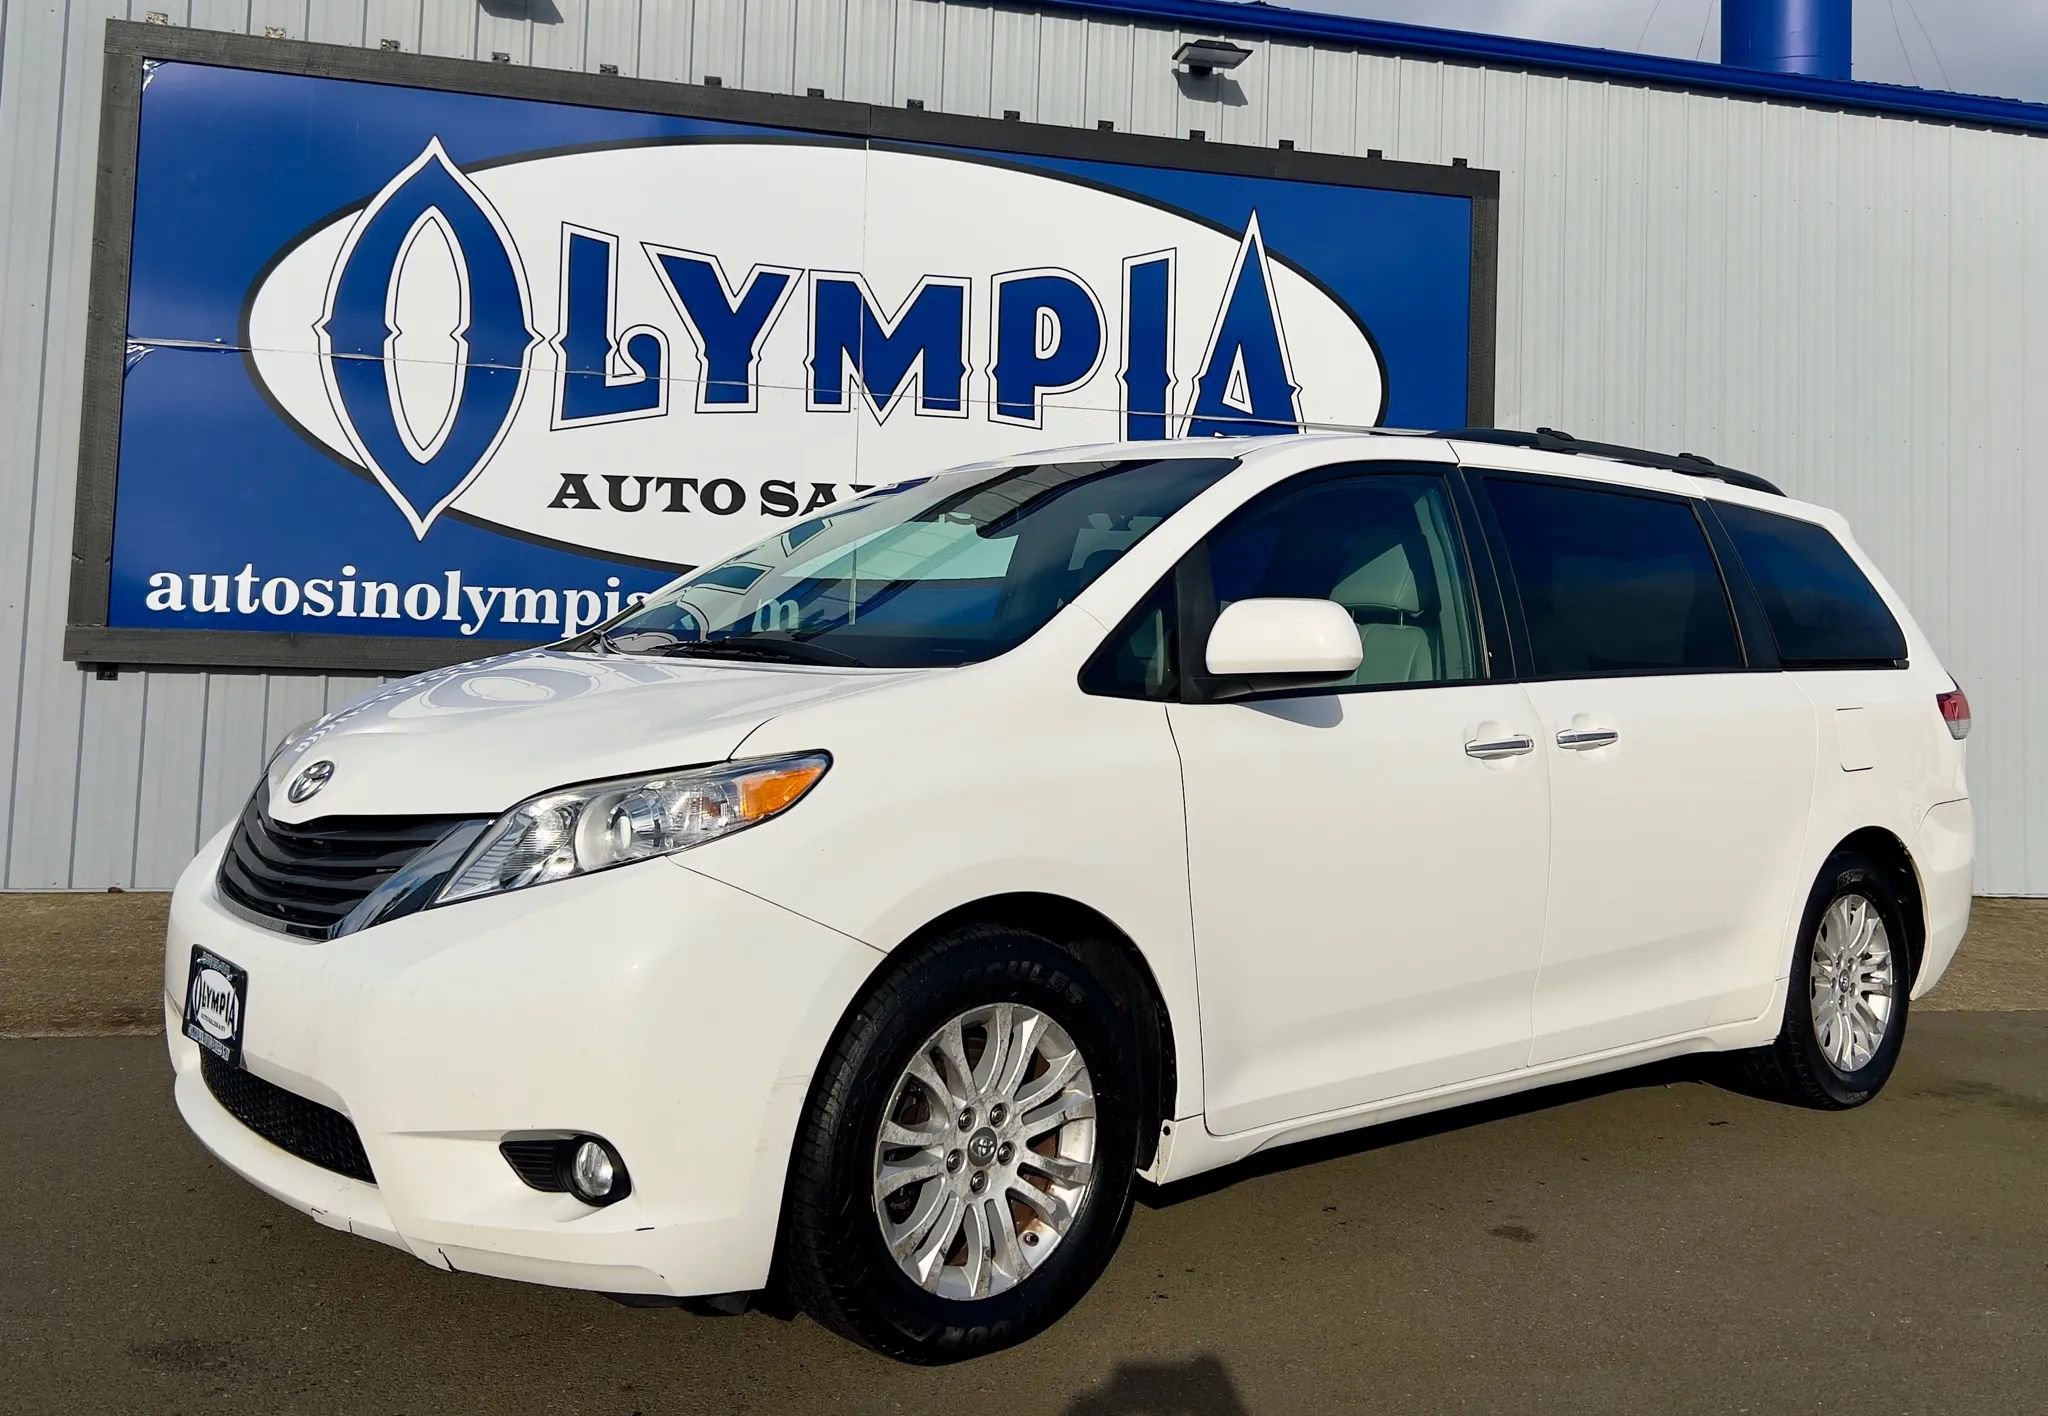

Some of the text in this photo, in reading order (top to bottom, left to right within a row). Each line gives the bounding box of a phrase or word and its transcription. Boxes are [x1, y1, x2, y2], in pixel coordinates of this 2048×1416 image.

[312, 135, 1305, 541] OLYMPIA
[547, 472, 877, 518] AUTO SA
[193, 966, 237, 1041] OLYMPIA
